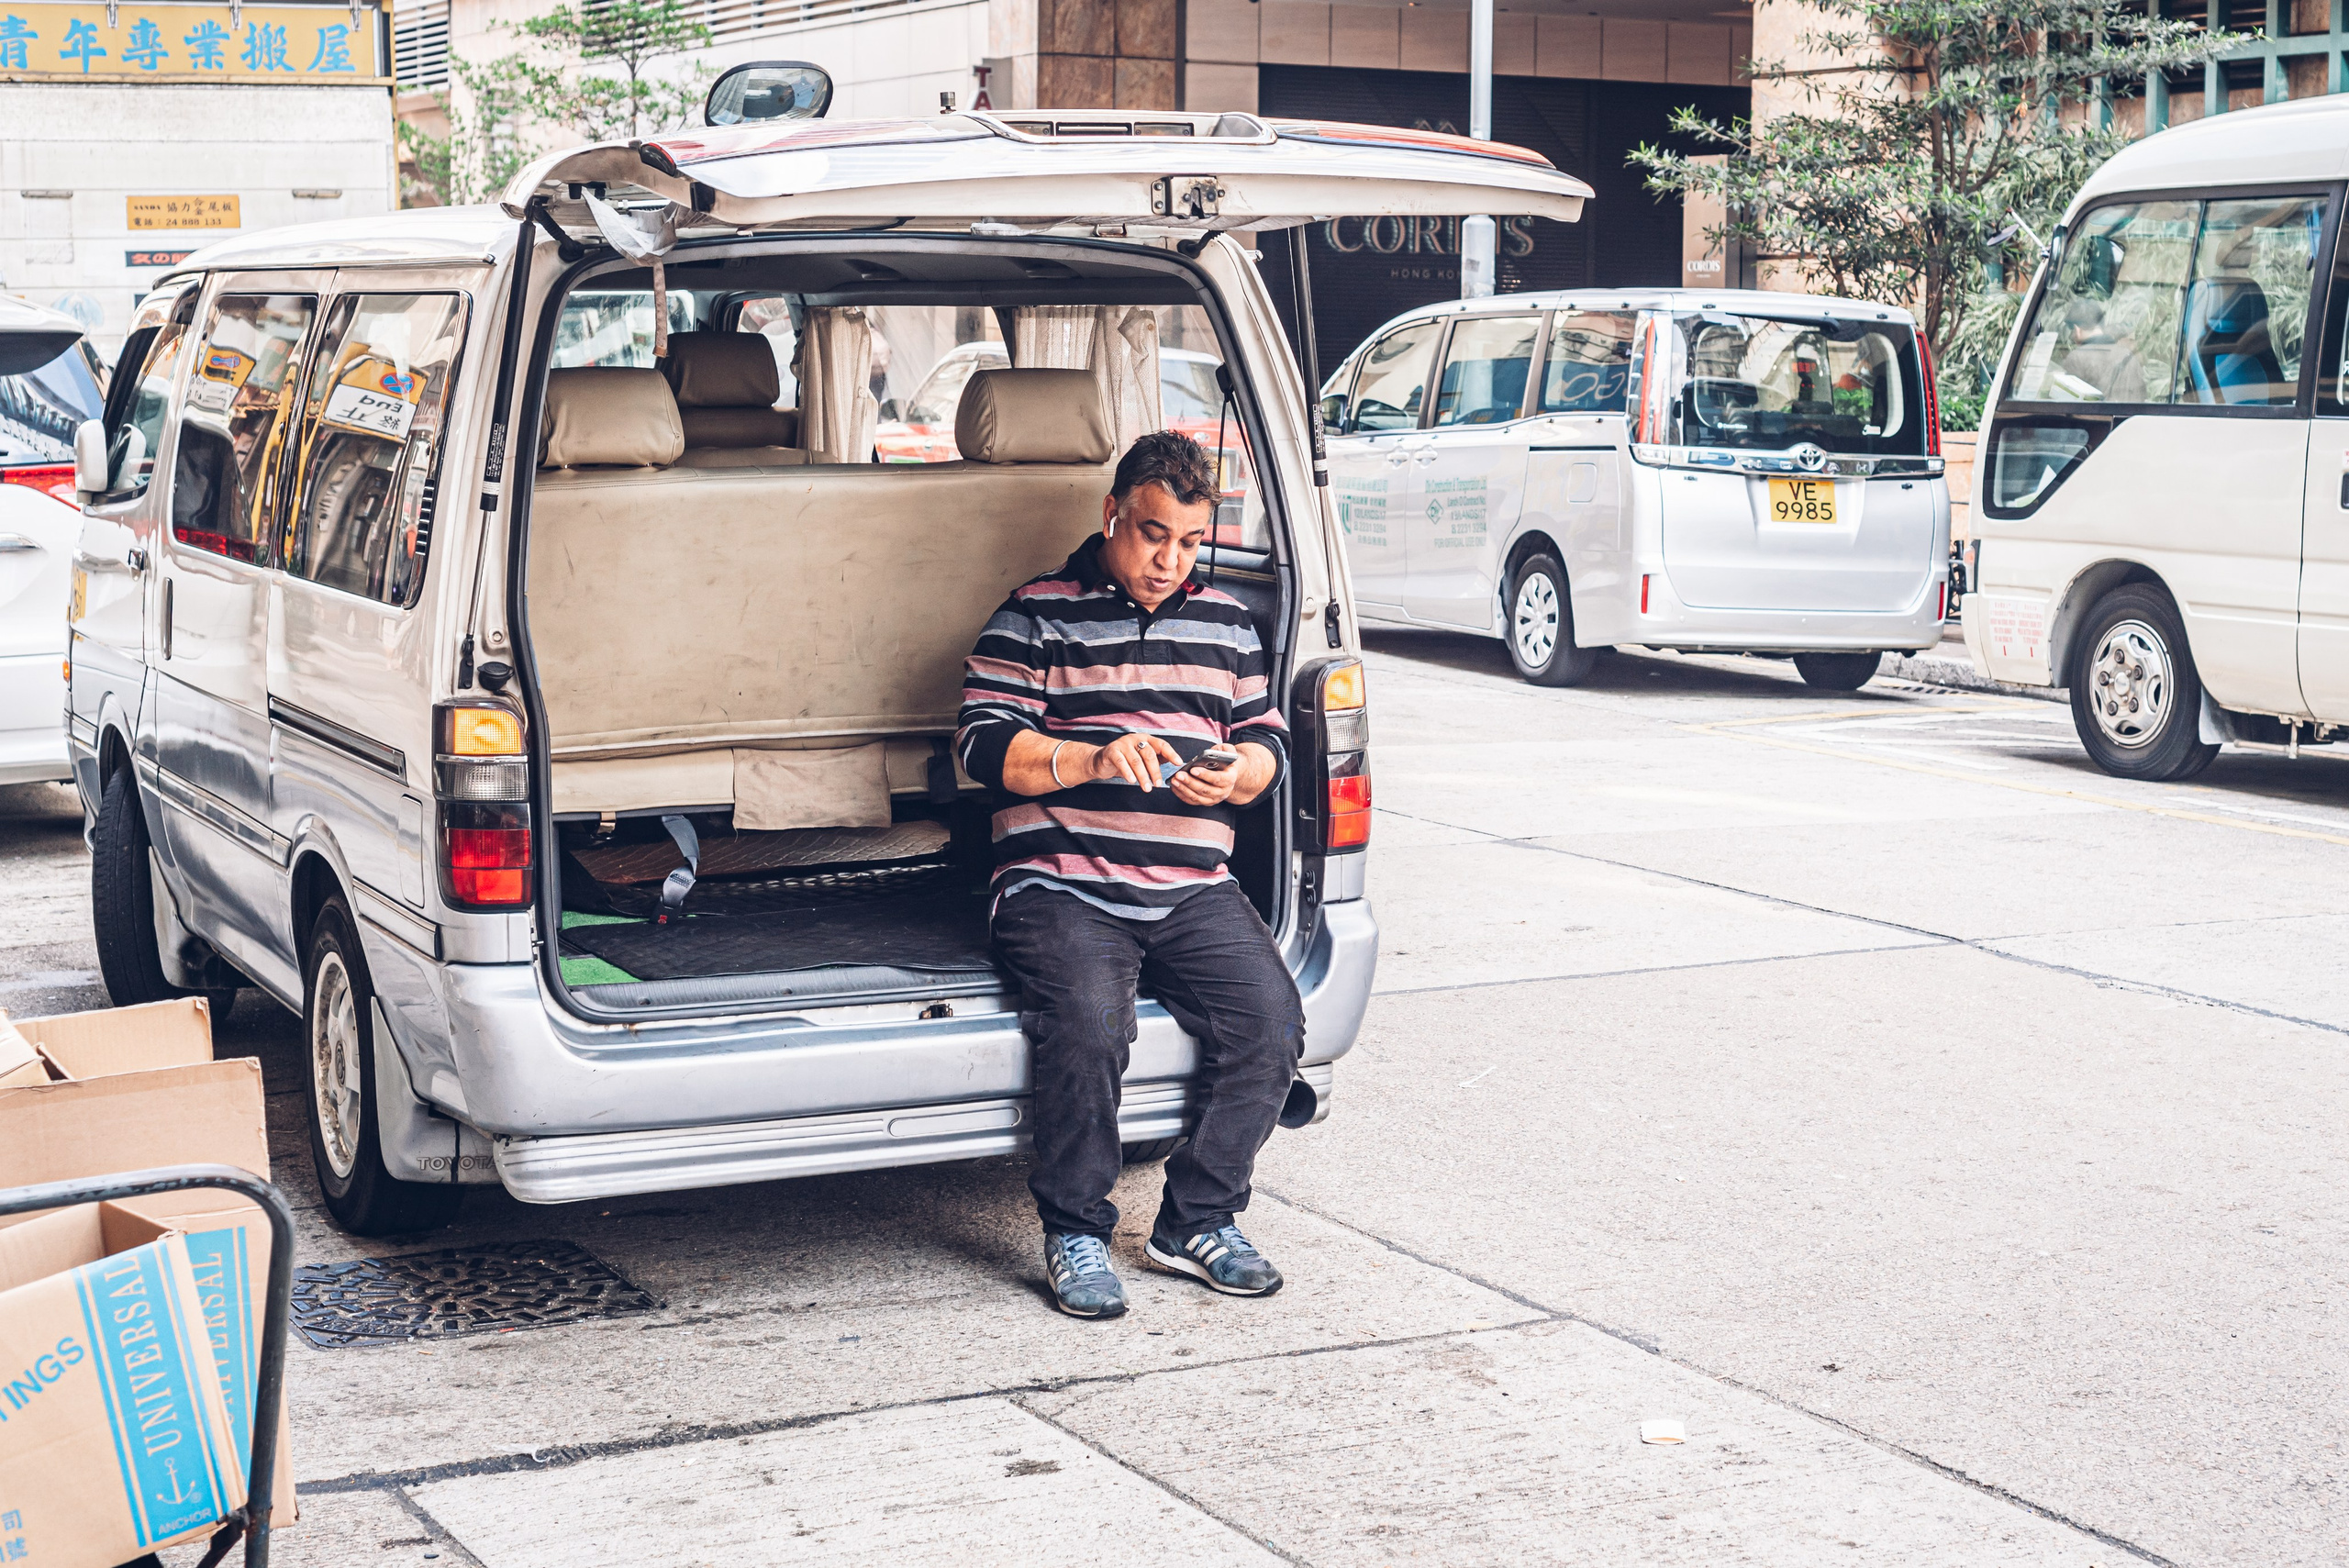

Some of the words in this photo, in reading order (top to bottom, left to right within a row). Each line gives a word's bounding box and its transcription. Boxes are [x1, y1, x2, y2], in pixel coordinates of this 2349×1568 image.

[0, 14, 356, 73] 青年專業搬屋
[1325, 215, 1534, 256] CORIS
[1390, 268, 1431, 279] HONG
[1788, 482, 1817, 501] VE
[1776, 501, 1833, 520] 9985
[417, 1156, 496, 1171] TOOTA
[105, 1255, 184, 1458] UNIVERSAL
[1, 1508, 22, 1531] 司
[158, 1507, 212, 1535] ANCHOR
